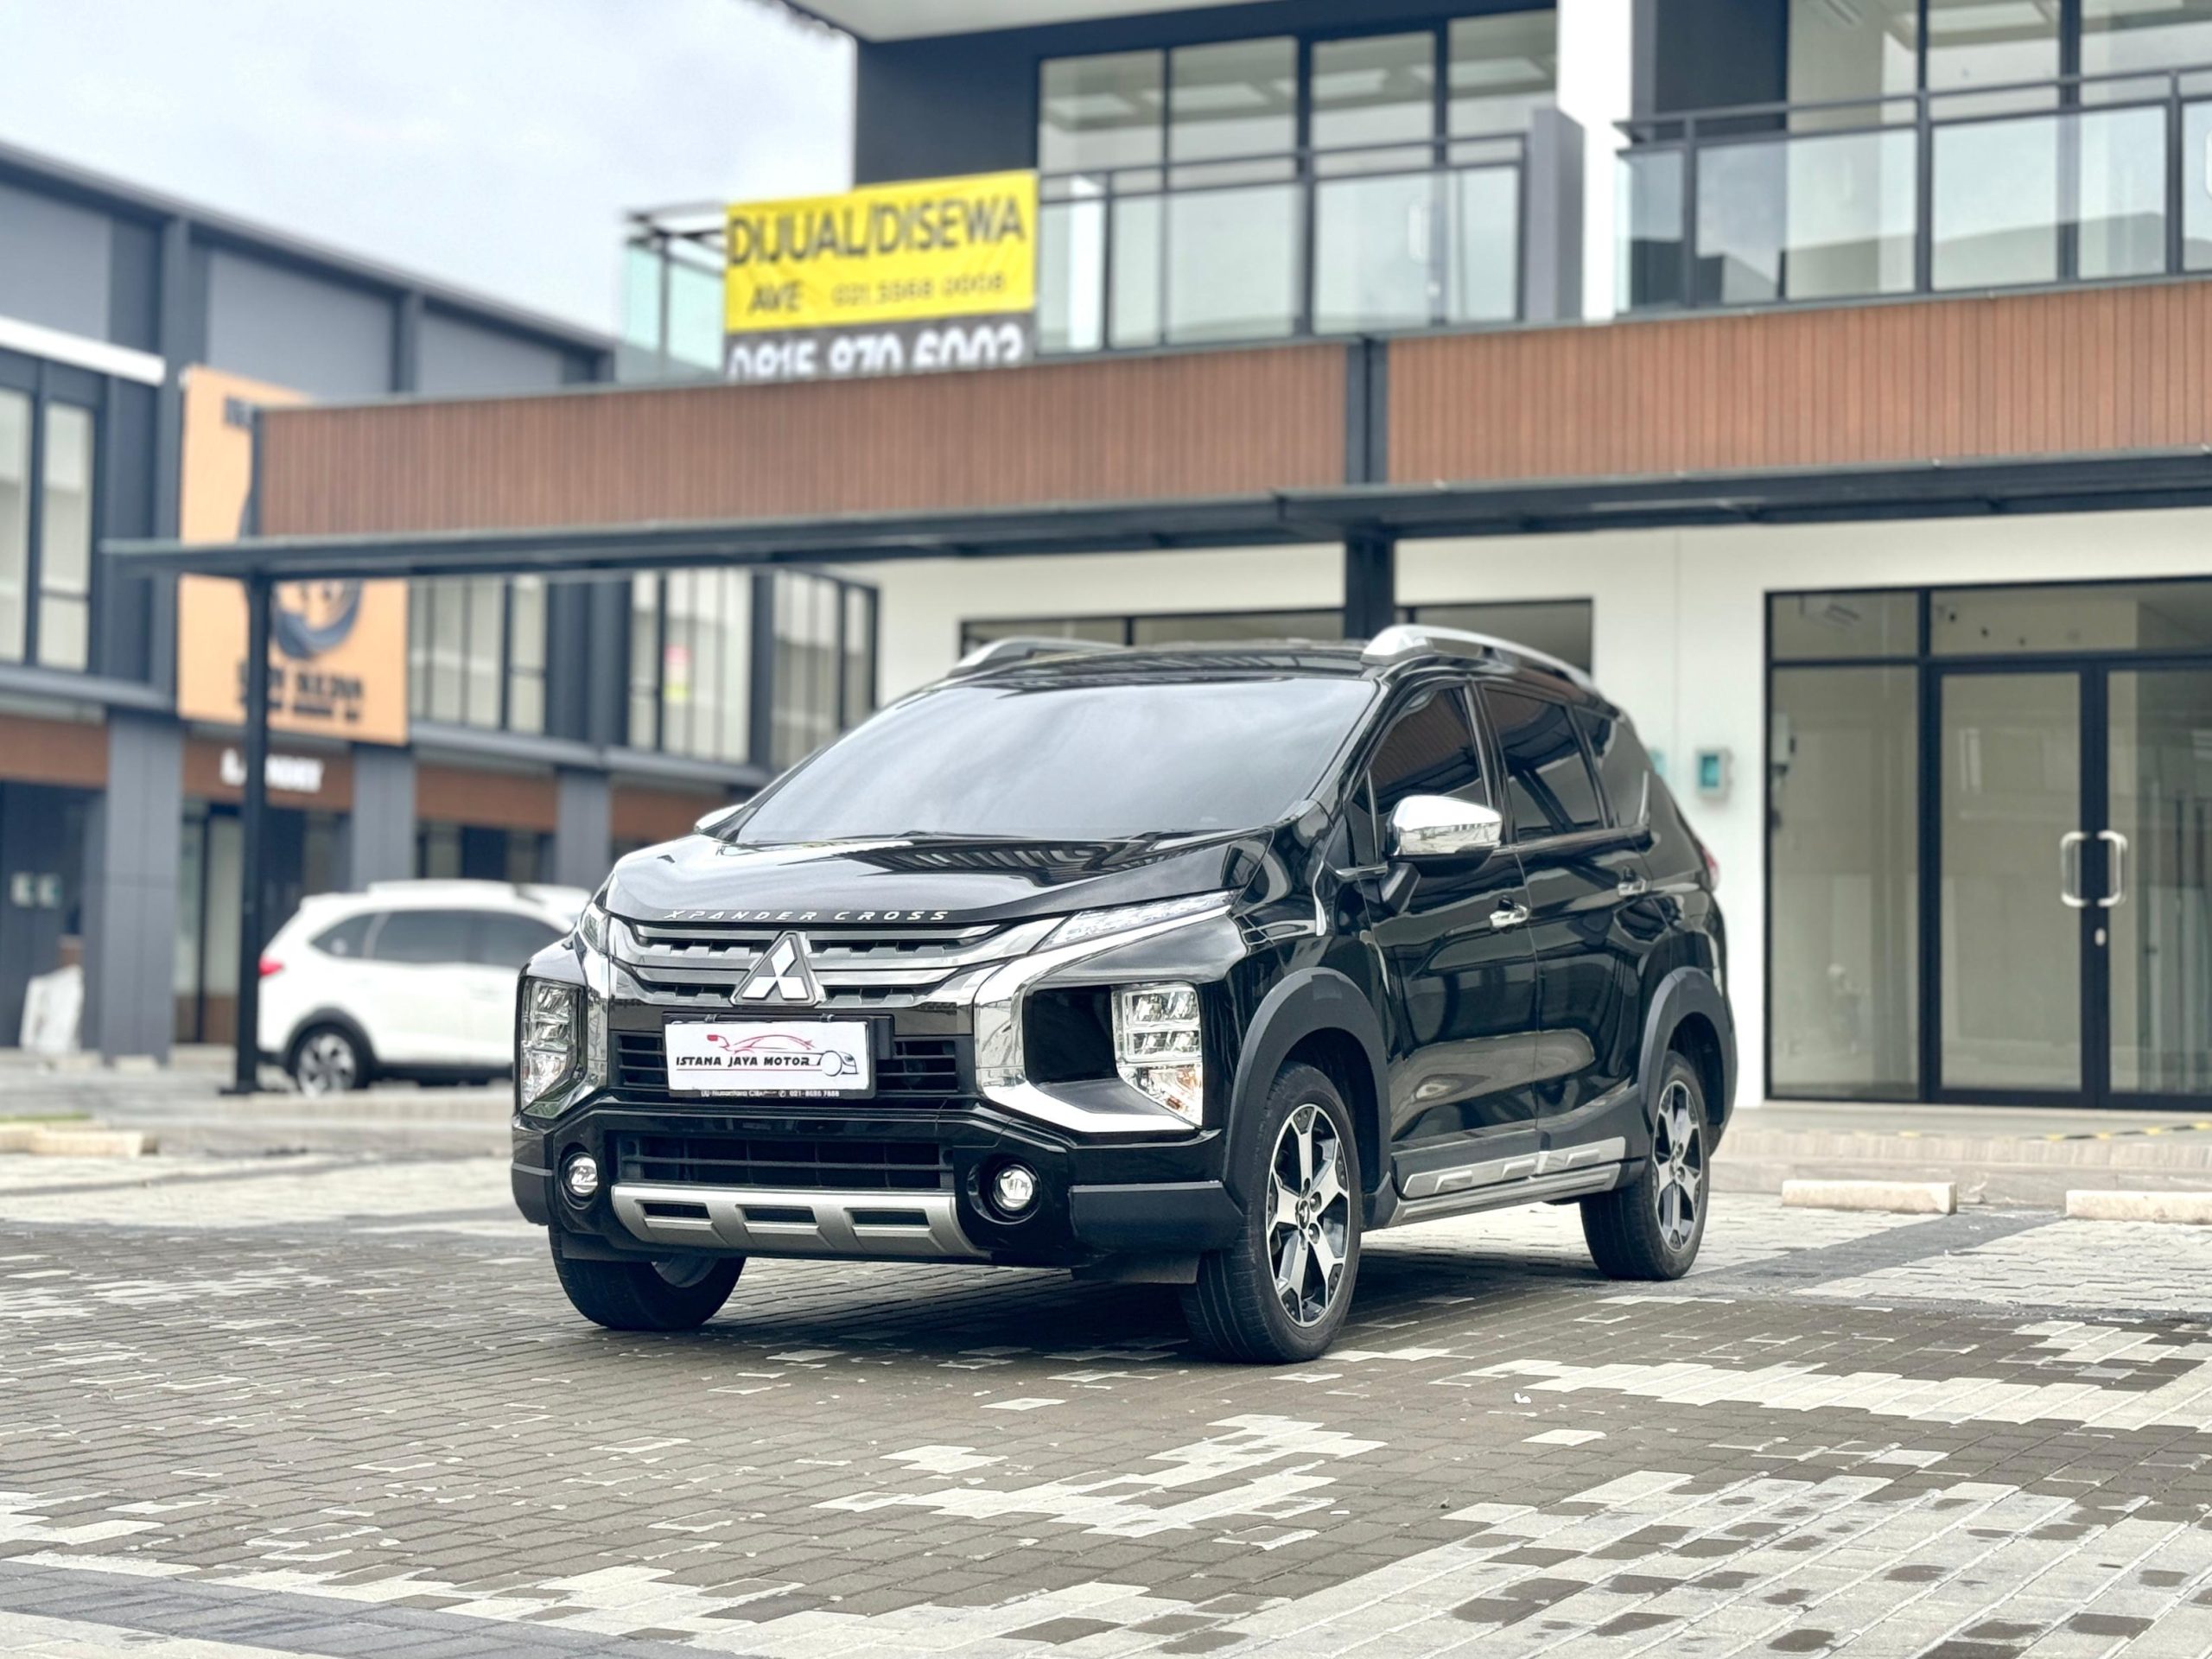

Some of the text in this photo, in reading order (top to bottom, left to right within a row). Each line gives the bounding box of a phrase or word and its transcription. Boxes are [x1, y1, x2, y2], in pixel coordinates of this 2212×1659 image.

[728, 195, 1027, 266] DIJUAL/DISEWA
[664, 910, 949, 922] XPANDER CROSS
[676, 1056, 810, 1067] ISTANA JAYA MOTOR
